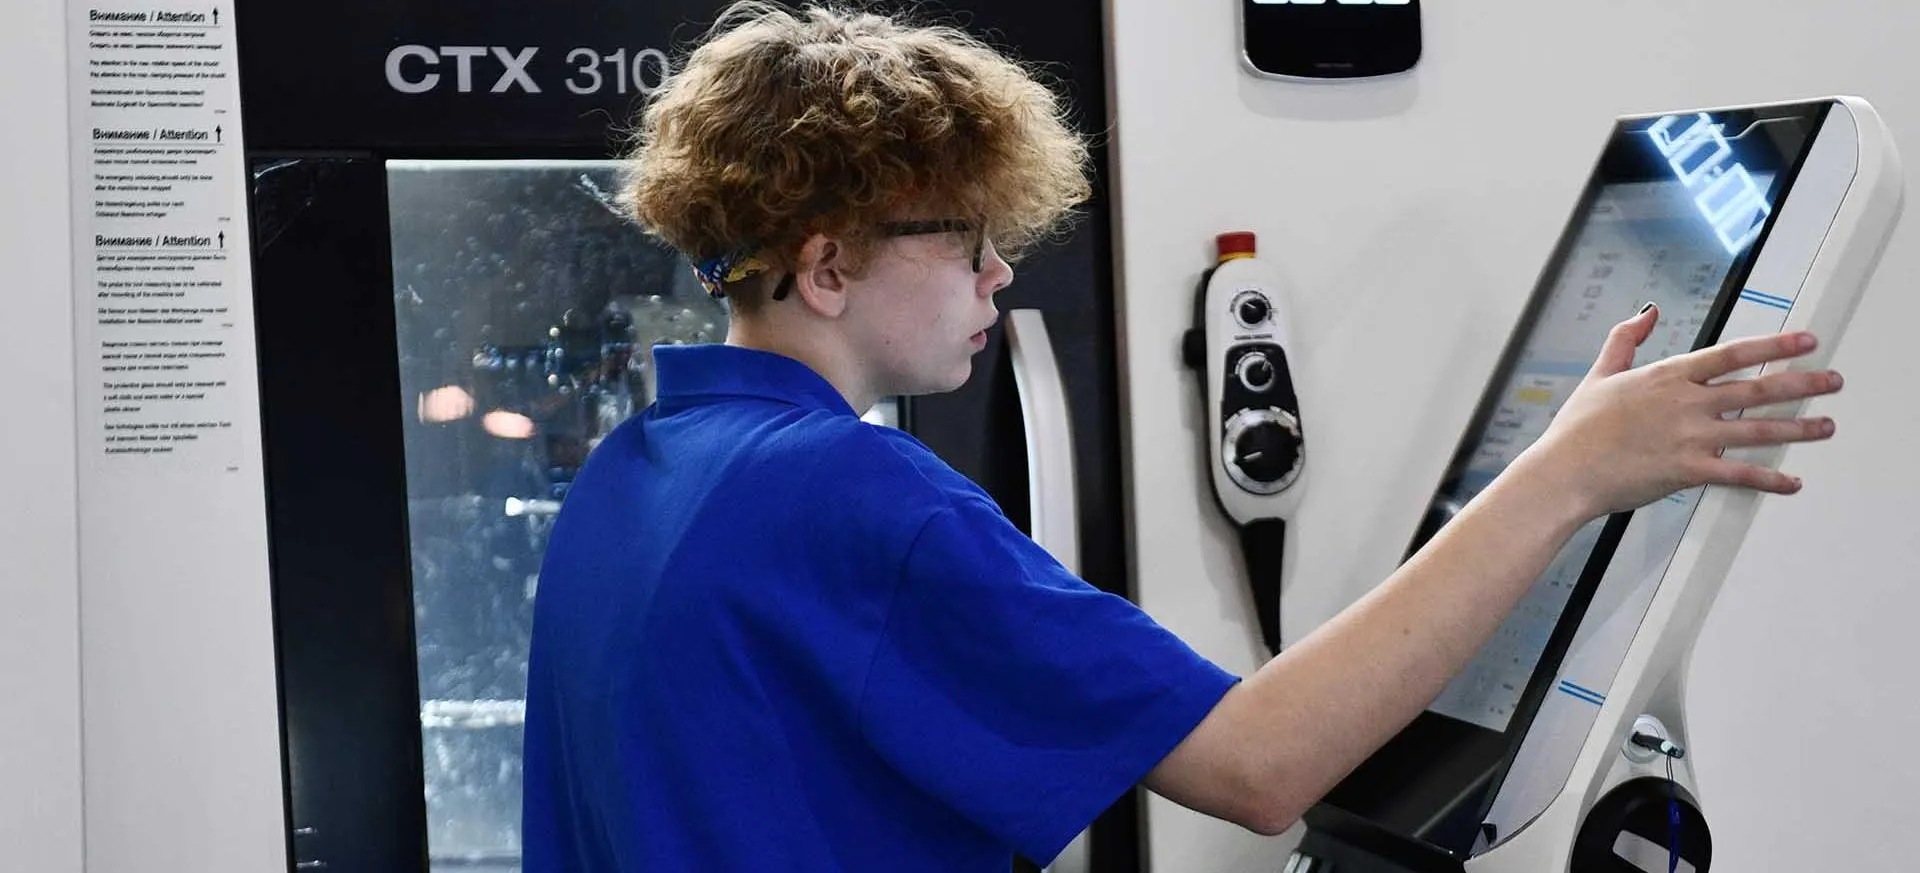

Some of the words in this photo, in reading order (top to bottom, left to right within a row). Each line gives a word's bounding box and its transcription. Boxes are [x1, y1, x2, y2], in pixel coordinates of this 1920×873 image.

[90, 9, 147, 21] Внимание
[157, 10, 205, 22] Attention
[385, 45, 542, 94] CTX
[565, 48, 670, 95] 310
[93, 128, 150, 140] Внимание
[160, 128, 208, 141] Attention
[96, 235, 153, 247] Внимание
[162, 235, 211, 246] Attention
